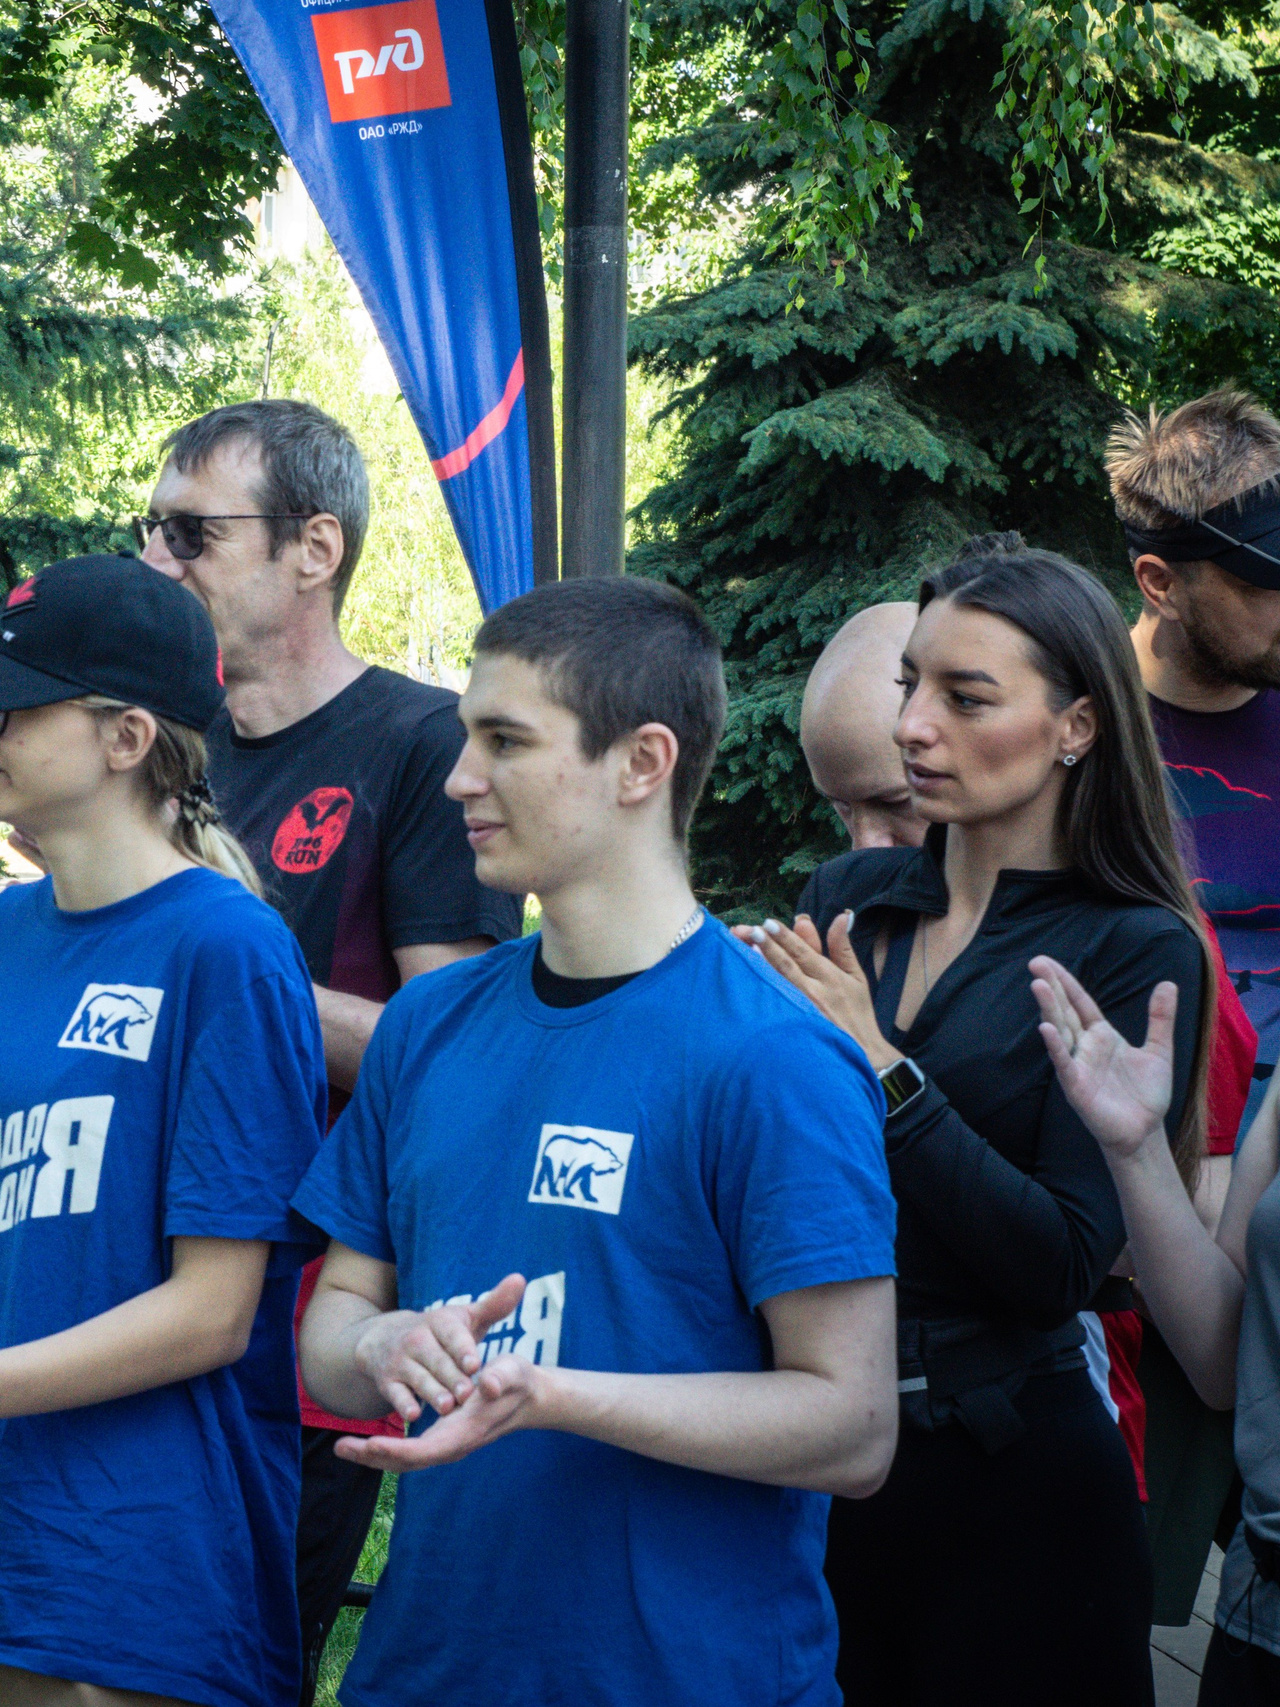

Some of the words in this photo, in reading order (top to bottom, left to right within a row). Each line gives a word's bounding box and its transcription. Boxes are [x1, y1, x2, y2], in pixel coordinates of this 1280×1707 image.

[358, 125, 385, 140] ОАО
[388, 120, 423, 135] «РЖД»
[284, 850, 322, 866] RUN
